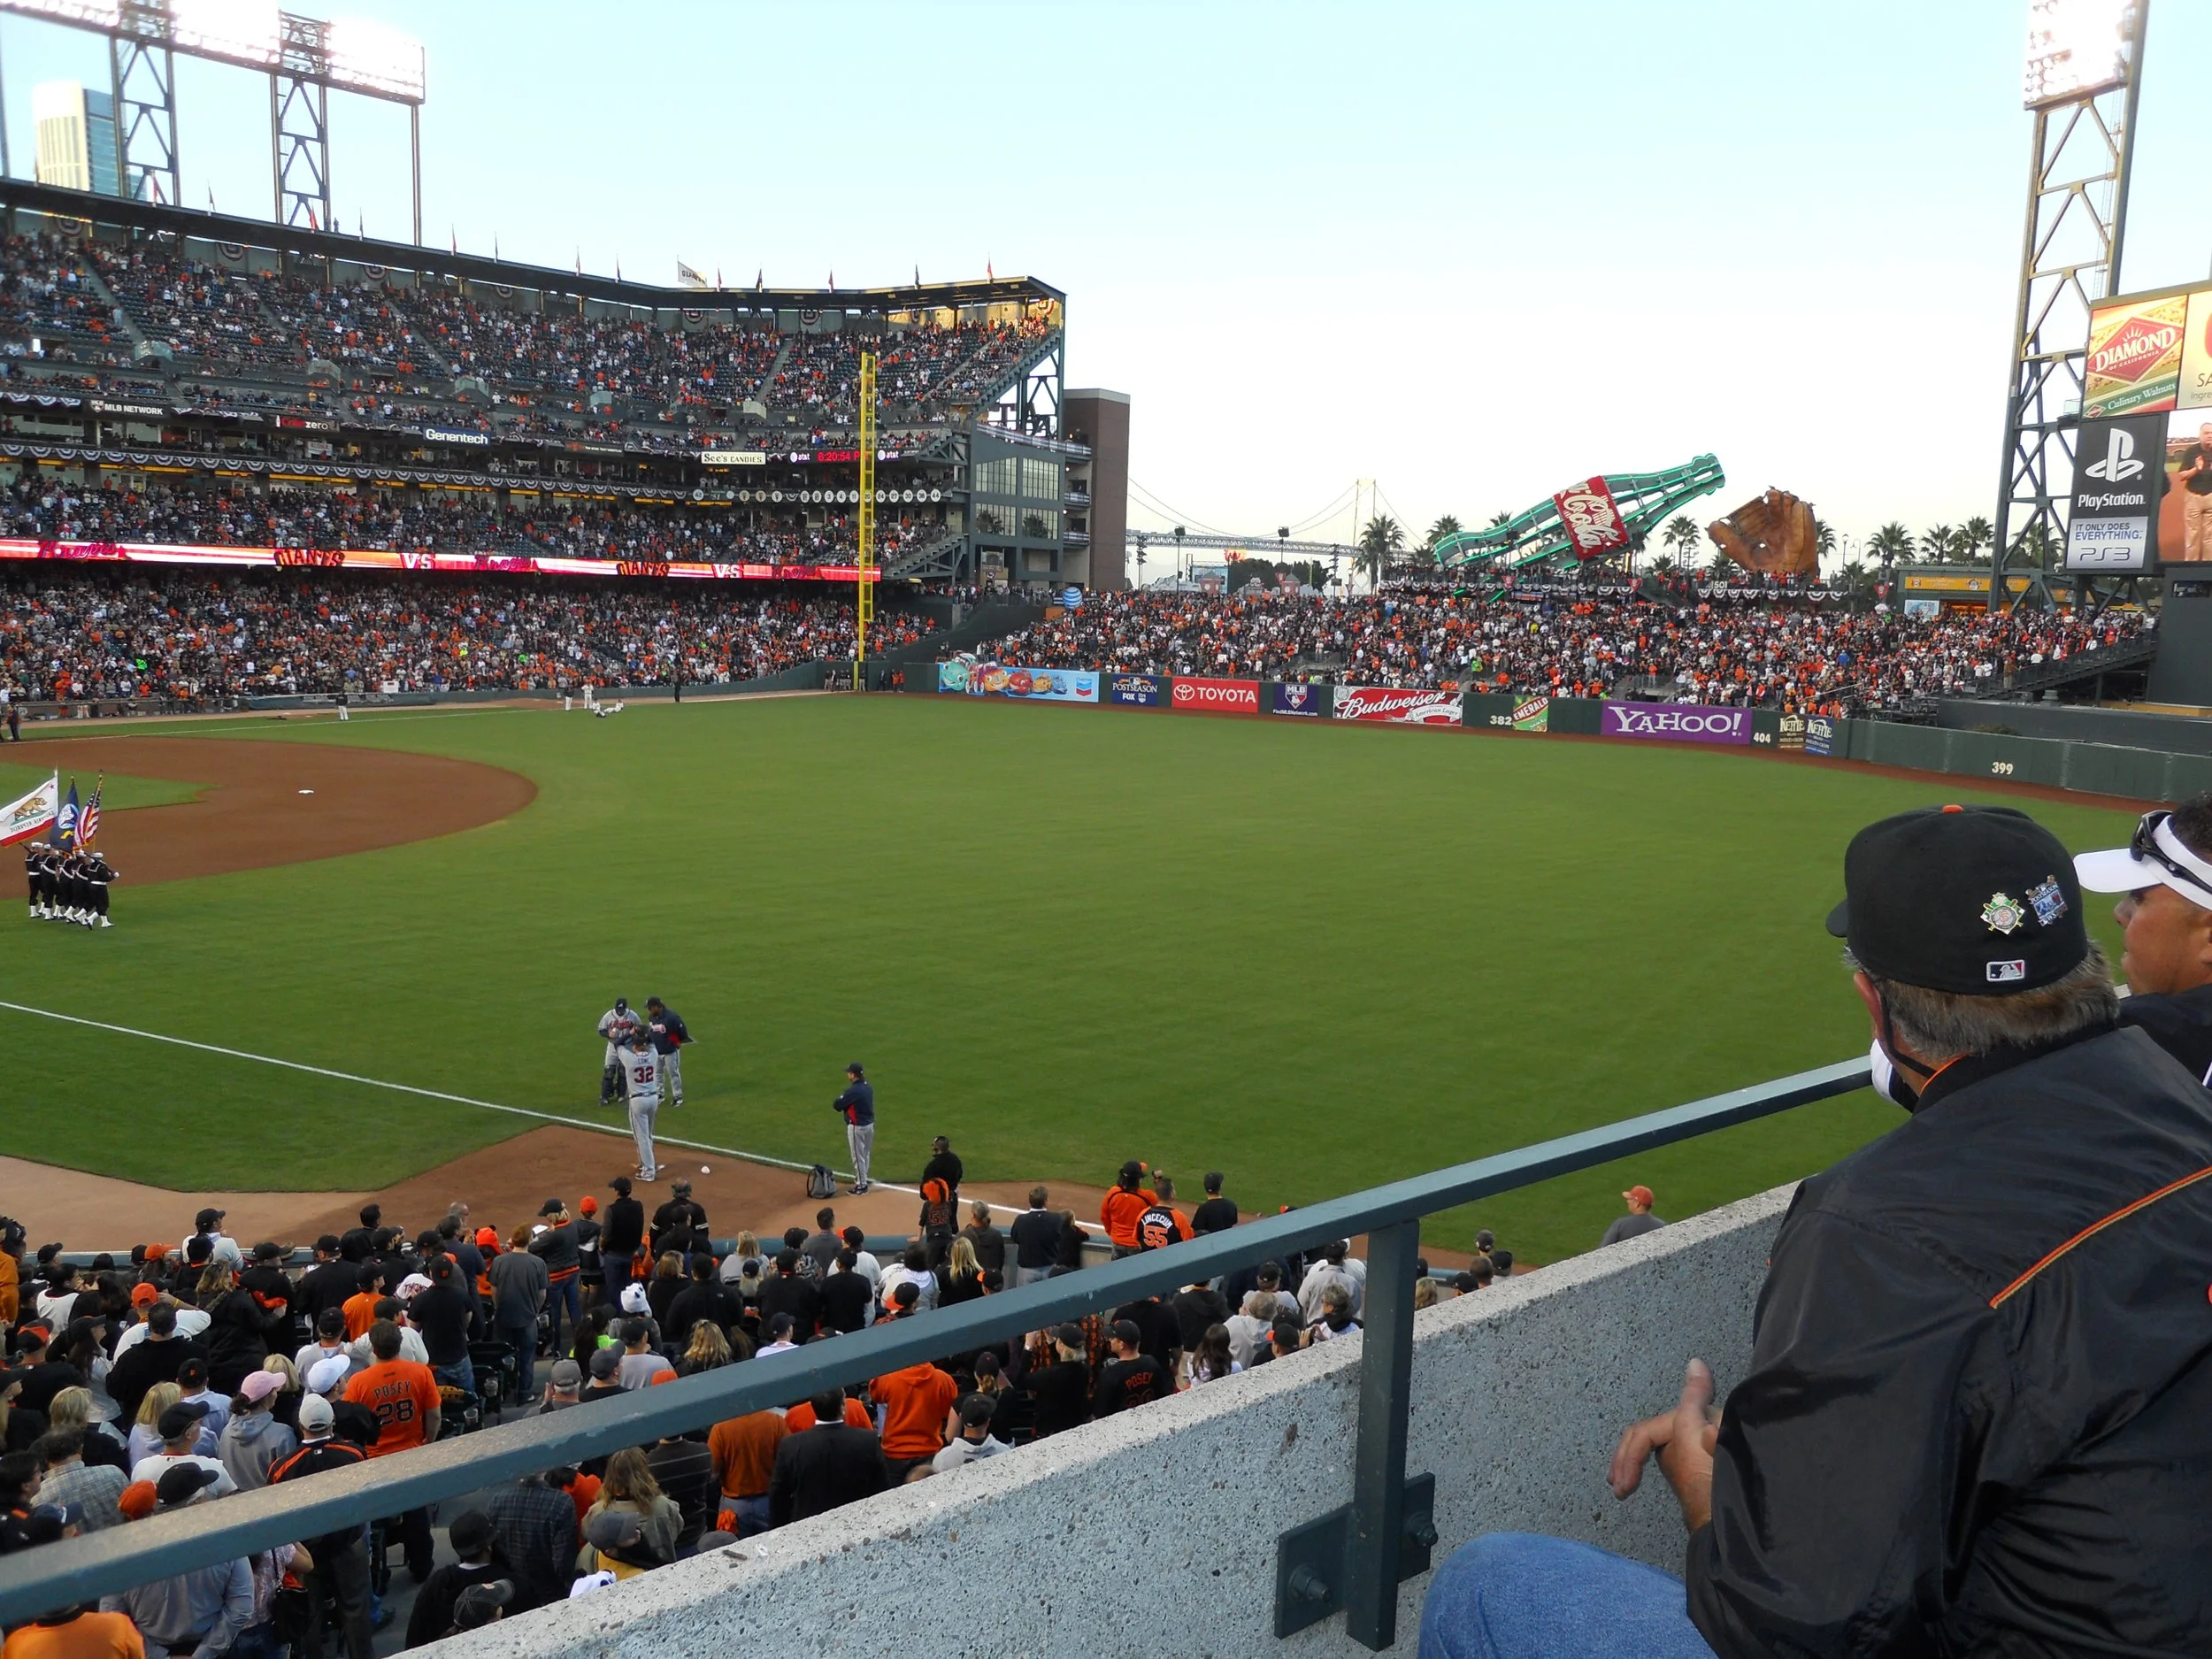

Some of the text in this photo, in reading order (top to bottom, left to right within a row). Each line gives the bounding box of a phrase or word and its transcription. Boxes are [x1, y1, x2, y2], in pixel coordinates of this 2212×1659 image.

[2095, 326, 2176, 373] DIAMOND
[2118, 350, 2160, 367] CALIFORNIA
[2108, 382, 2177, 411] Culinary Walnuts
[123, 405, 163, 415] NETWORK
[305, 420, 329, 430] zero
[426, 428, 488, 445] Genentech
[704, 452, 728, 463] See's
[2078, 492, 2144, 511] PlayStation
[2108, 522, 2131, 531] DOES
[273, 549, 346, 566] GIANTS
[401, 552, 434, 569] VS
[2079, 547, 2131, 561] PS3
[616, 560, 671, 576] GIANTS
[712, 563, 743, 579] VS
[1714, 580, 1727, 589] 501
[1112, 682, 1158, 694] POSTSEASON
[1197, 687, 1256, 703] TOYOTA
[1337, 690, 1447, 718] Budweiser
[1416, 707, 1459, 718] American Lager
[1513, 697, 1548, 721] EMERALD
[1489, 715, 1512, 726] 382
[1608, 706, 1742, 736] YAHOO!
[1753, 732, 1771, 743] 404
[1992, 762, 2014, 775] 399
[634, 1065, 654, 1084] 32
[1141, 1213, 1174, 1229] LINCECUM
[1143, 1225, 1168, 1248] 55
[373, 1380, 411, 1400] POSEY
[1125, 1371, 1154, 1392] POSEY
[376, 1398, 415, 1425] 28
